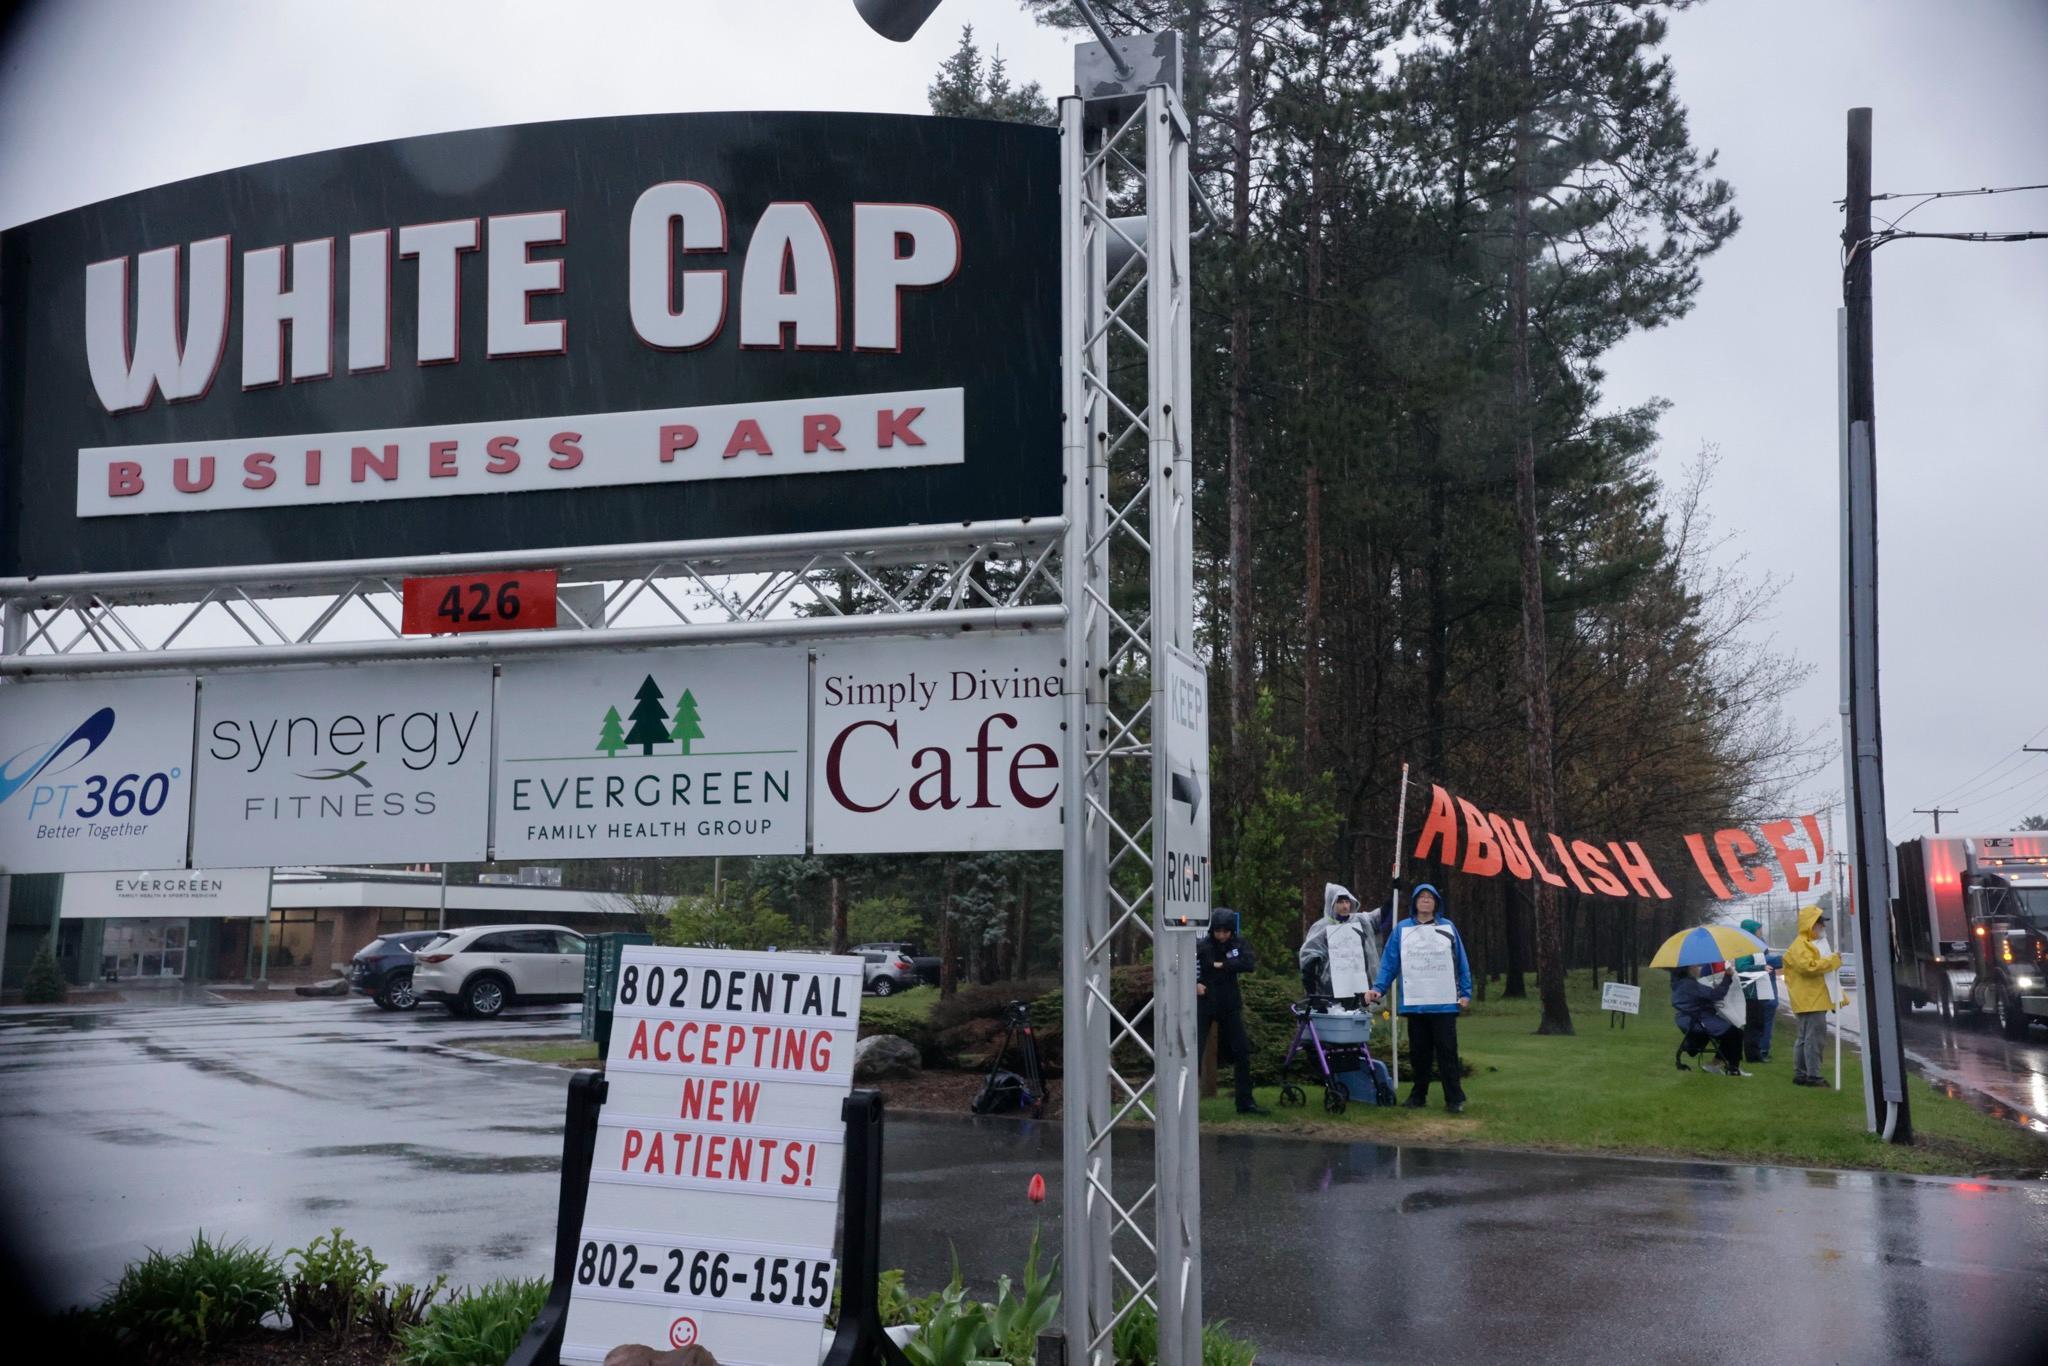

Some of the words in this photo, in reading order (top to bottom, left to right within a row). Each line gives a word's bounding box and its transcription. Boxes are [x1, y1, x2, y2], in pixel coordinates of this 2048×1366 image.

[86, 210, 567, 416] WHITE
[629, 180, 962, 353] CAP
[108, 432, 584, 497] BUSINESS
[659, 407, 927, 463] PARK
[438, 581, 521, 622] 426
[824, 673, 938, 712] Simply
[951, 671, 1060, 702] Divine
[1171, 672, 1203, 732] KEEP
[210, 710, 479, 773] synergy
[826, 713, 1060, 813] Cafe
[245, 791, 437, 820] FITNESS
[512, 769, 791, 811] EVERGREEN
[36, 824, 82, 840] Better
[87, 822, 149, 840] Together
[527, 824, 597, 841] FAMILY
[608, 822, 686, 839] HEALTH
[697, 818, 772, 836] GROUP
[1414, 783, 1673, 899] ABOLISH
[1683, 815, 1827, 901] ICE!
[115, 880, 222, 891] EVERGREEN
[1167, 851, 1208, 903] RIGHT
[620, 965, 689, 1007] 802
[700, 969, 848, 1018] DENTAL
[628, 1020, 833, 1073] ACCEPTING
[680, 1078, 761, 1123] NEW
[621, 1129, 816, 1187] PATIENTS!
[578, 1241, 831, 1308] 802-266-1515
